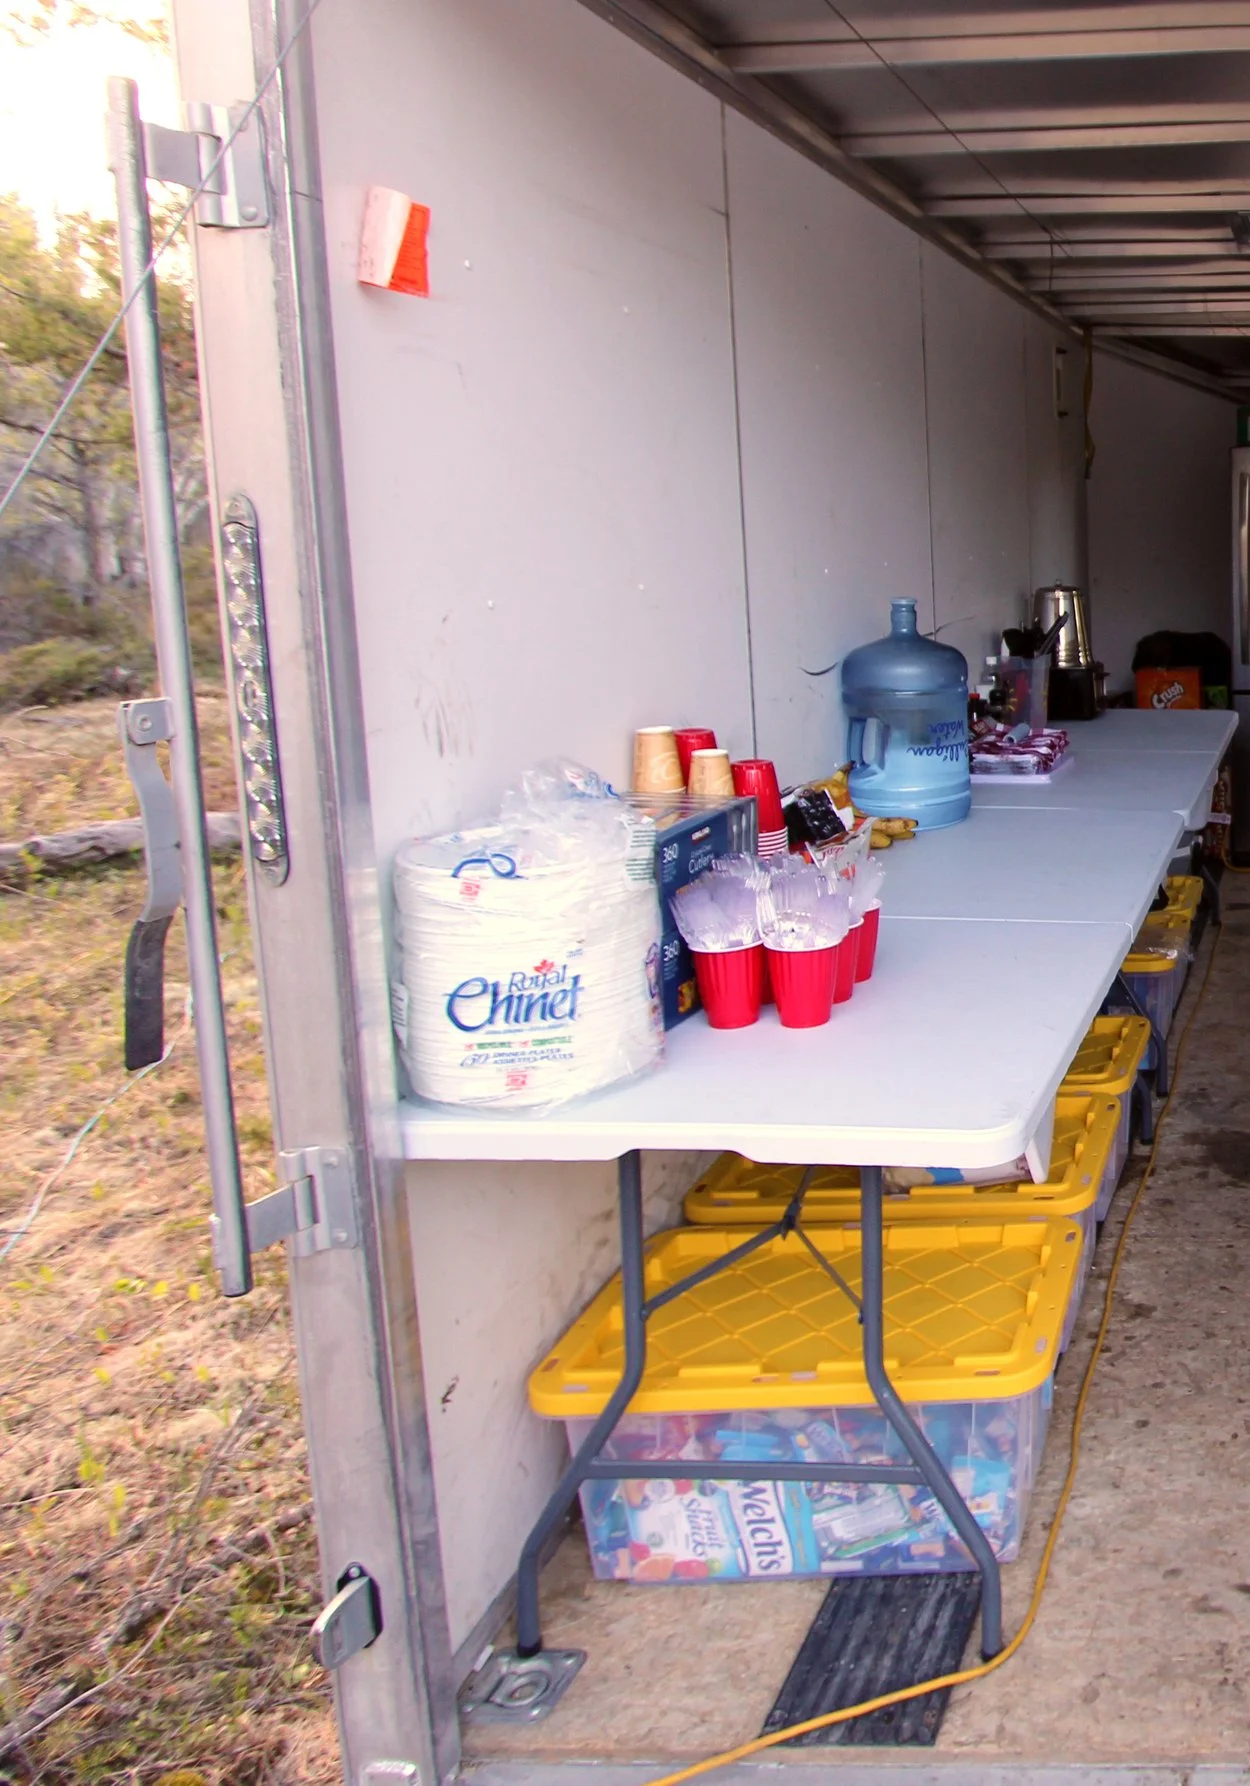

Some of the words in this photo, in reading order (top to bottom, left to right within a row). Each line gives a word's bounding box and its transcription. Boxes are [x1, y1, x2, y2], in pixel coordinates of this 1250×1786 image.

[1152, 682, 1184, 709] Crush
[929, 719, 964, 740] Water
[663, 843, 679, 863] 360
[664, 940, 680, 961] 360
[508, 964, 567, 993] Royal
[442, 974, 584, 1032] Chinet
[680, 1496, 708, 1558] Snacks
[698, 1507, 725, 1550] Fruit
[738, 1480, 785, 1573] Welch's
